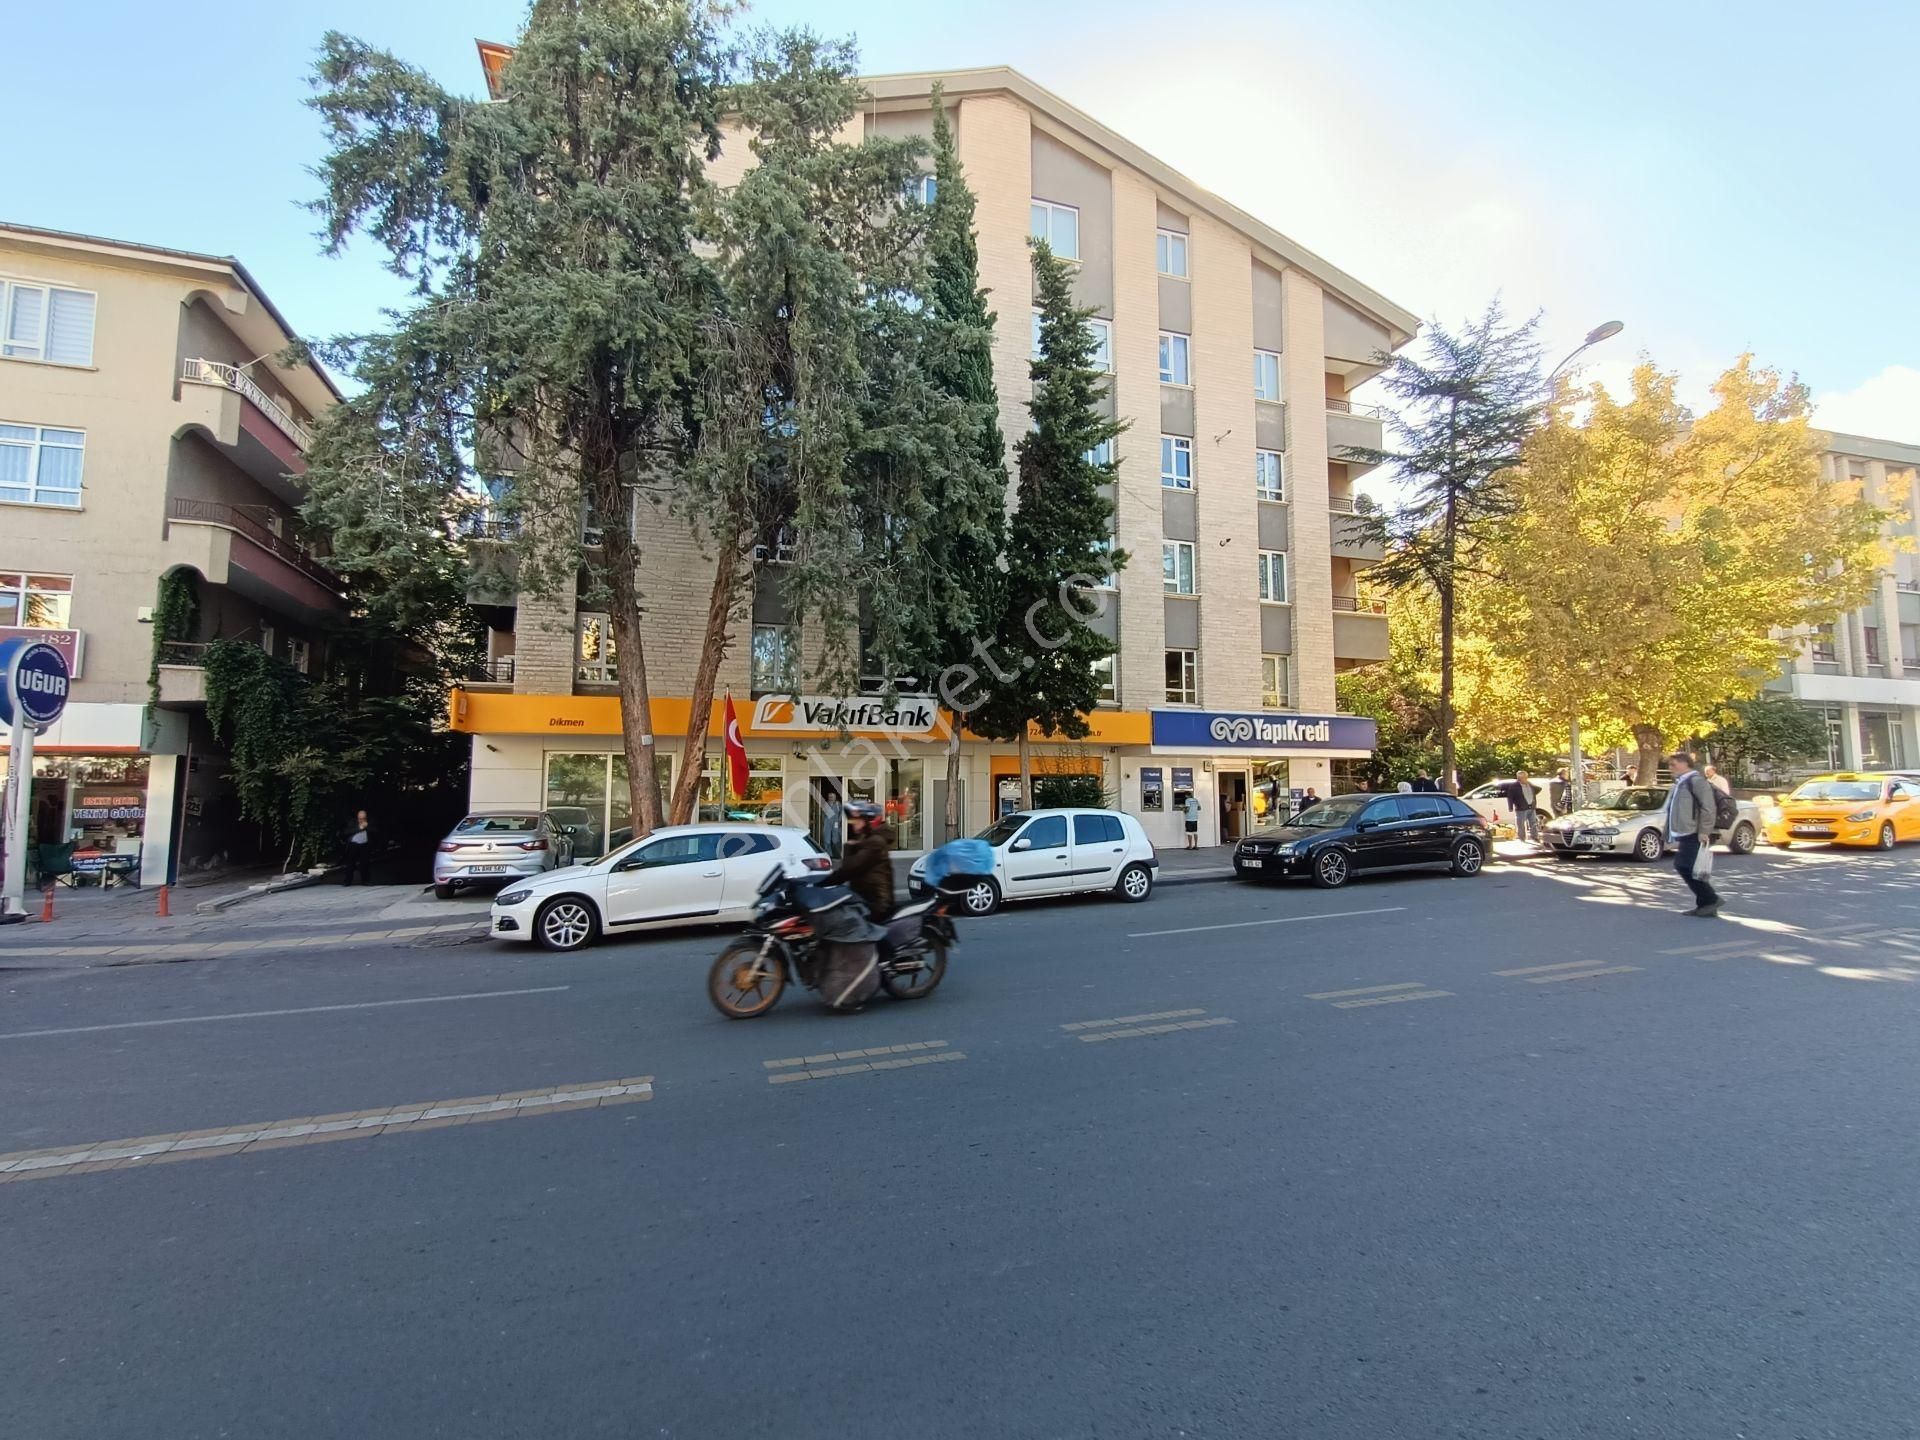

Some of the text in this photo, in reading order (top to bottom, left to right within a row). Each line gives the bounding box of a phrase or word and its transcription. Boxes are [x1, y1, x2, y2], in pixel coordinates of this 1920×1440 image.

[19, 669, 67, 697] UĞUR
[549, 718, 584, 727] Dikmen
[803, 702, 930, 727] VakıfBank
[1252, 718, 1330, 744] YapıKredi
